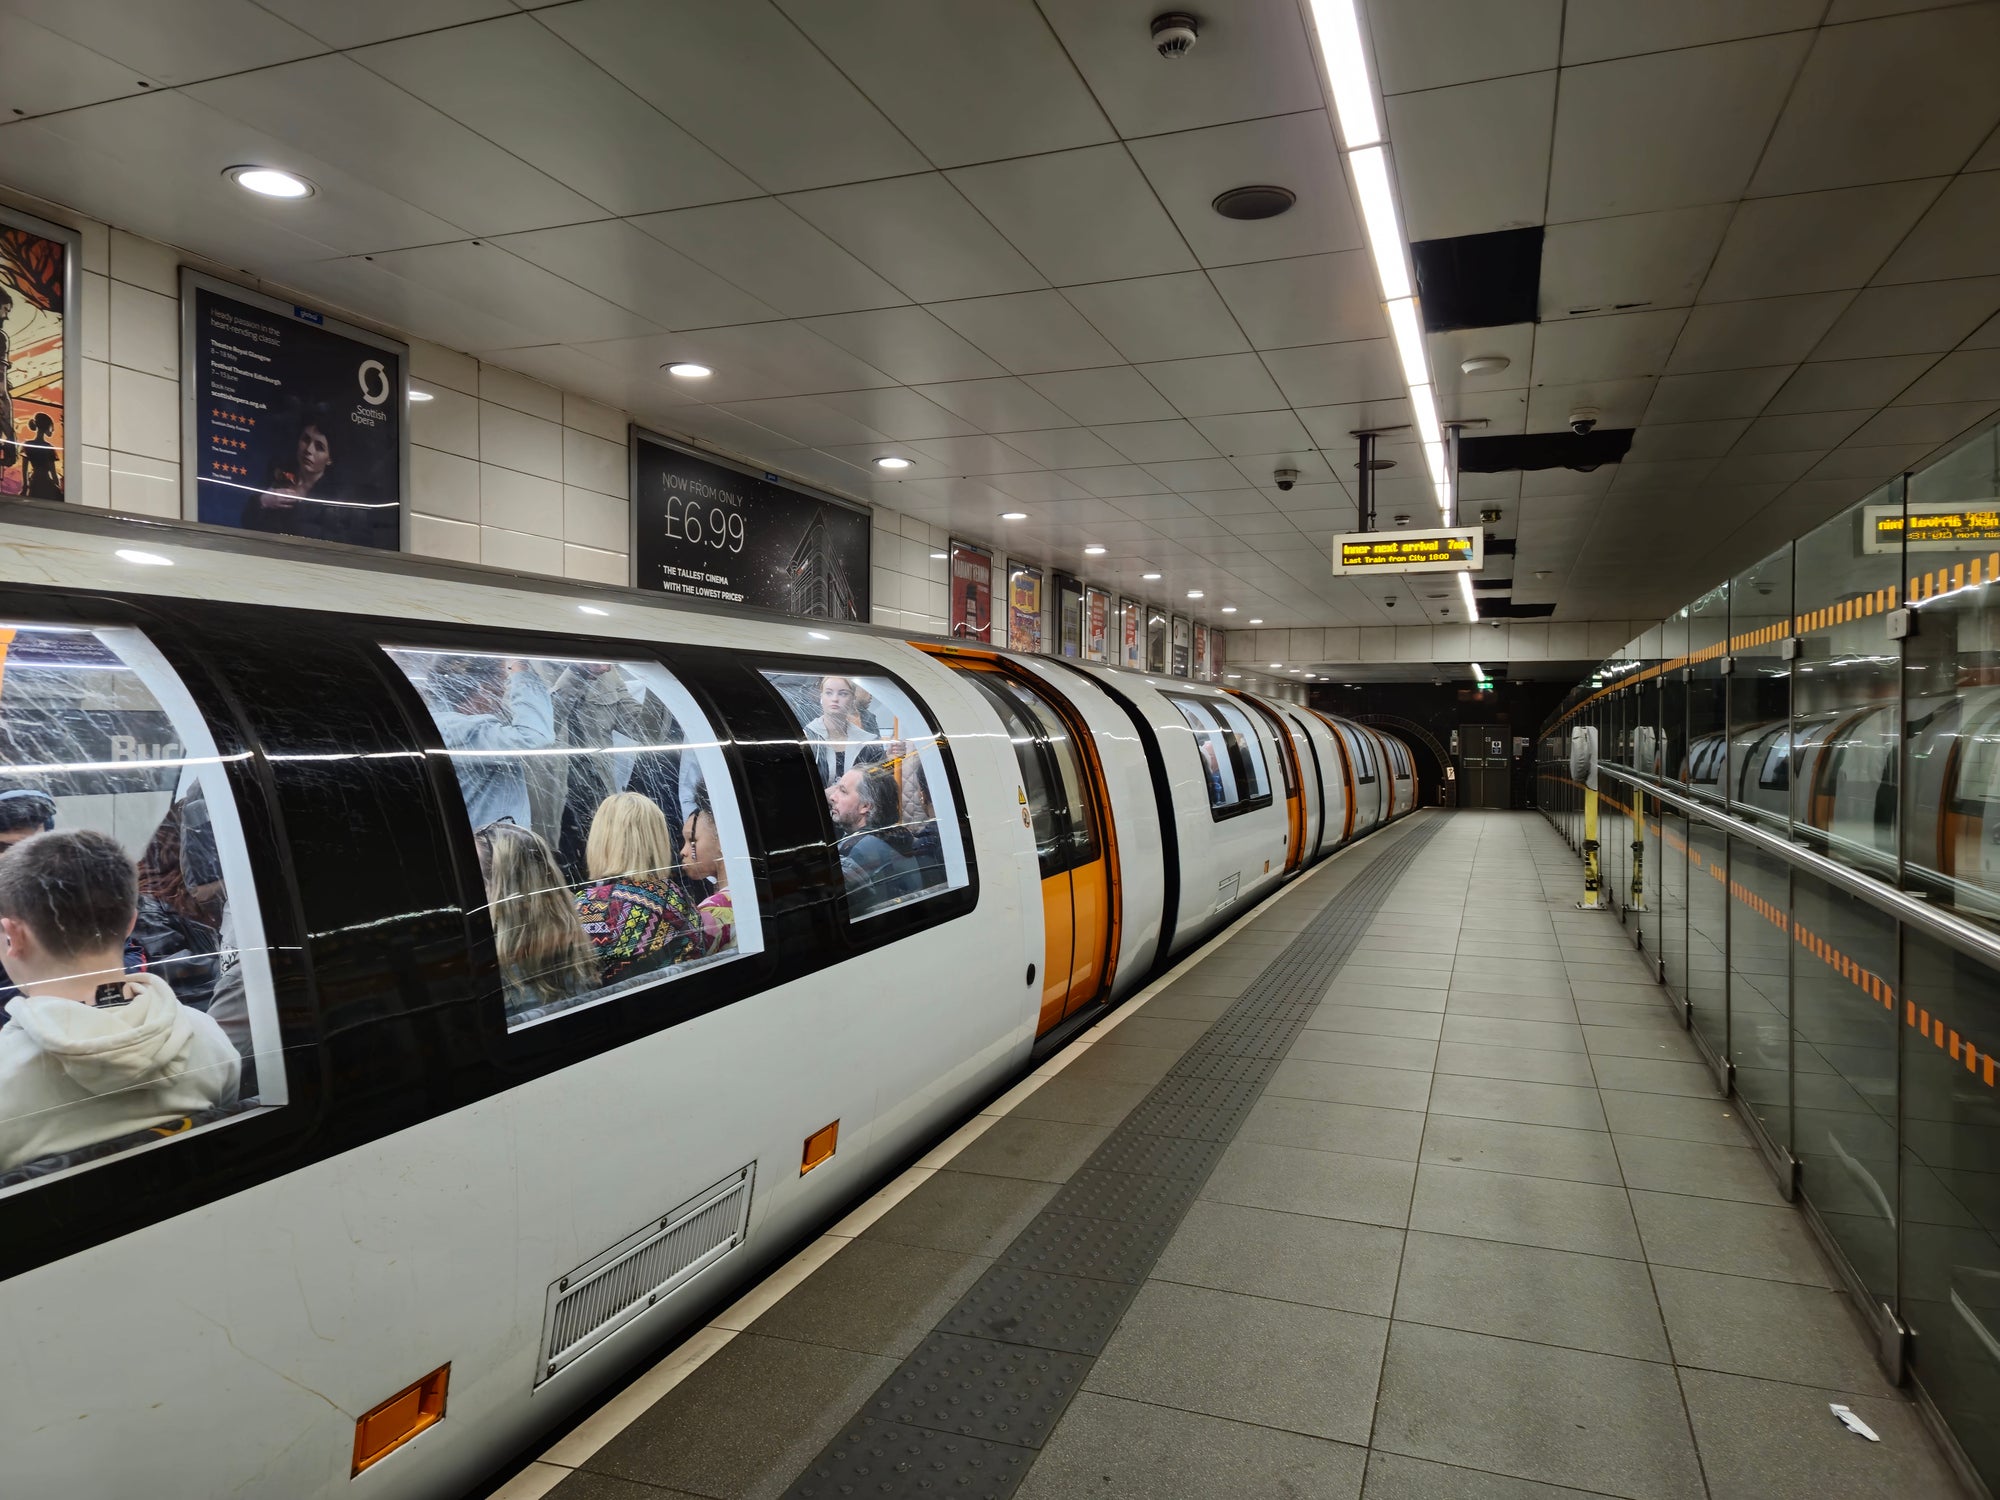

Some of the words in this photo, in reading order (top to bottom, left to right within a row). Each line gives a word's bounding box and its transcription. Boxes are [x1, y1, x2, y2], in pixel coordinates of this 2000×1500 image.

[269, 327, 281, 337] the
[351, 412, 376, 428] Opera
[356, 404, 387, 422] Scottish
[662, 471, 688, 492] NOW
[689, 480, 717, 500] FROM
[718, 489, 743, 507] ONLY
[664, 495, 744, 553] £6.99
[1374, 542, 1399, 553] next
[1402, 540, 1439, 552] arrival
[1344, 557, 1362, 565] Last
[1364, 555, 1386, 564] Train
[1408, 553, 1427, 562] City
[663, 565, 676, 576] THE
[677, 567, 705, 581] TALLEST
[705, 573, 729, 585] CINEMA
[663, 580, 681, 592] WITH
[681, 583, 695, 595] THE
[696, 586, 721, 599] LOWEST
